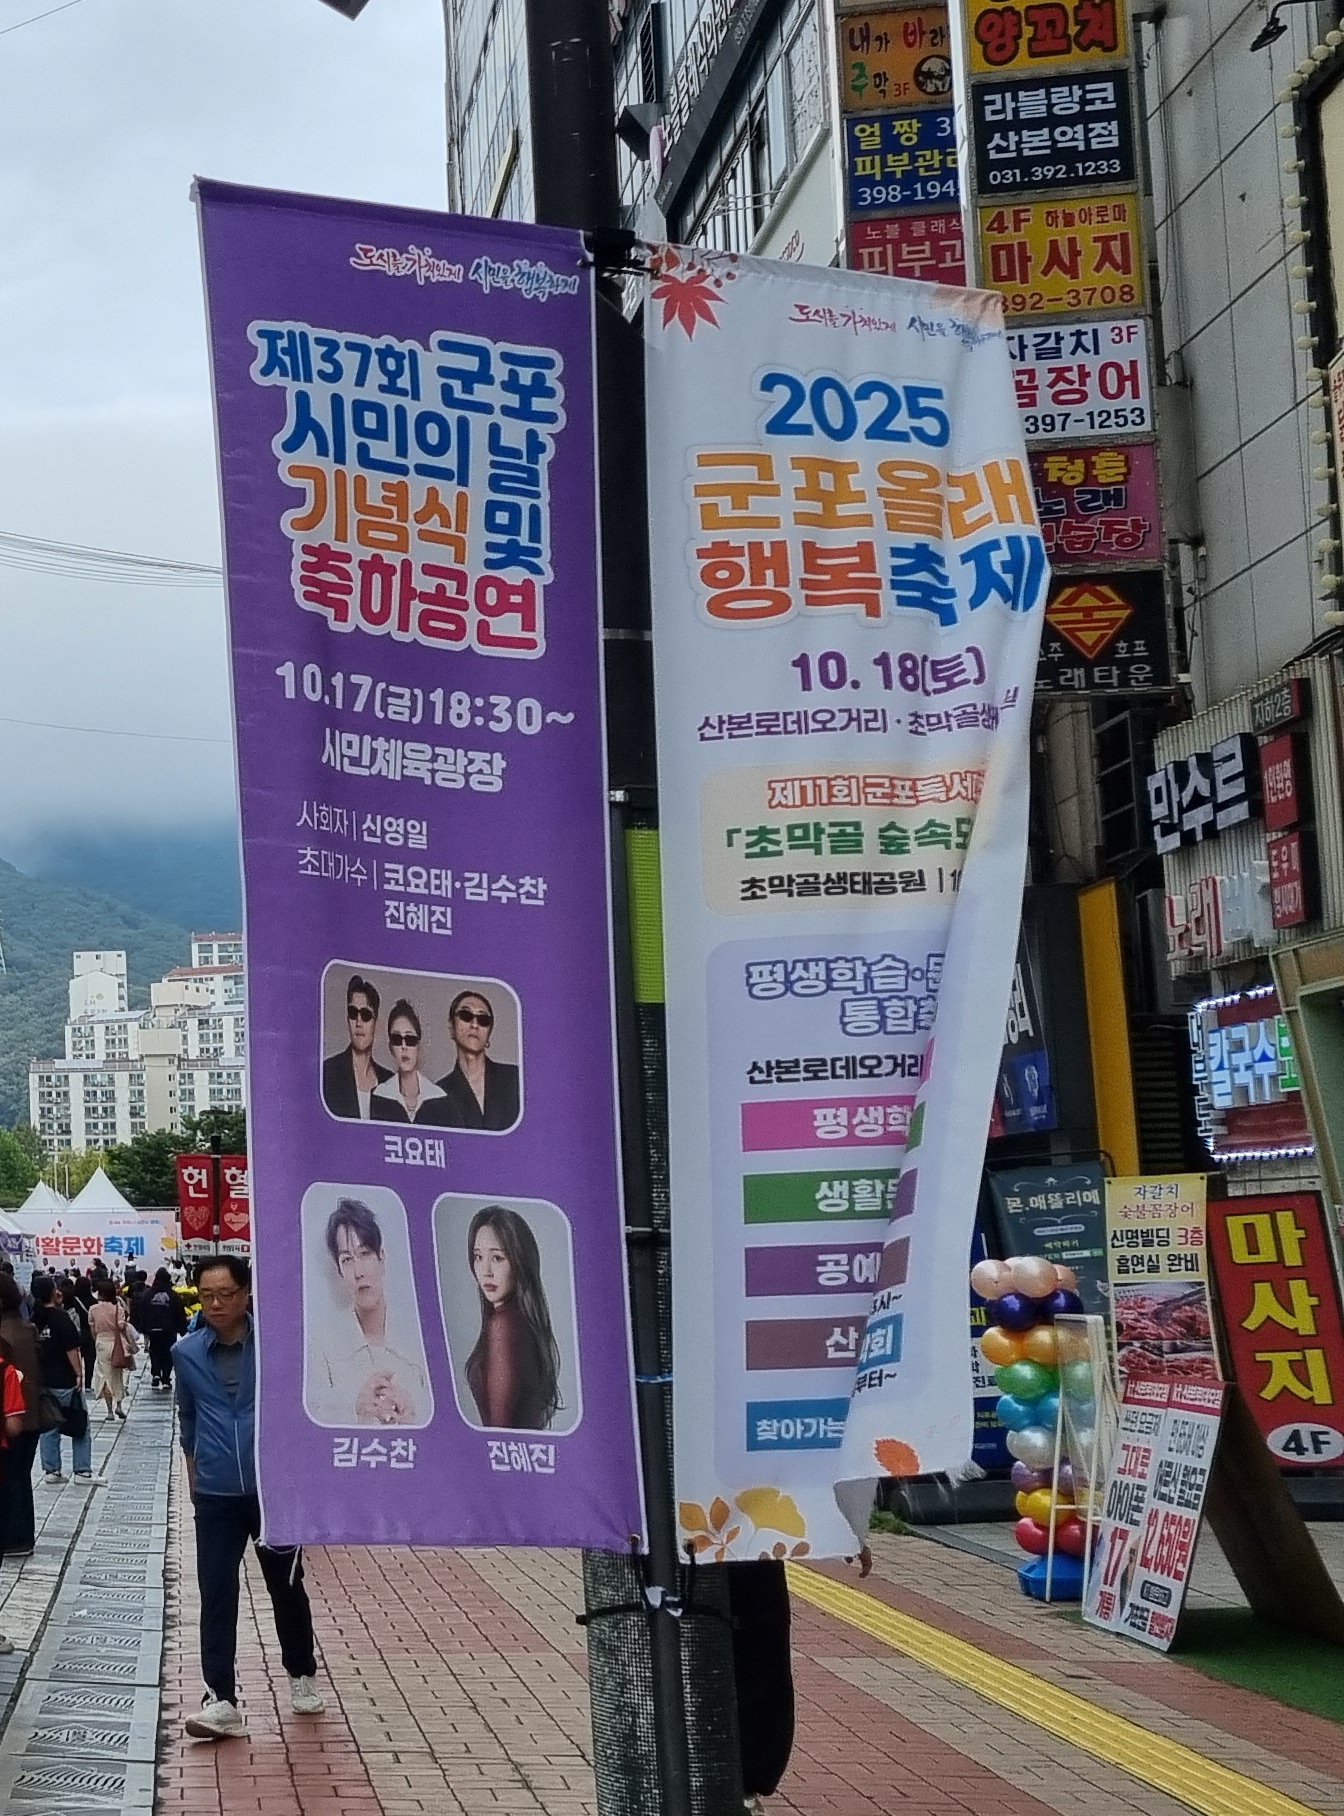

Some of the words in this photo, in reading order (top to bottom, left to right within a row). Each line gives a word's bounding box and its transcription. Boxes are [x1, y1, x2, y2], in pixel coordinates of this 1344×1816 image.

[848, 21, 891, 55] 내가
[851, 61, 889, 98] 주막
[893, 82, 910, 97] 3F
[983, 82, 1117, 121] 라블랑코
[986, 120, 1120, 160] 산본역점
[989, 159, 1122, 185] 031.392.1233
[866, 221, 903, 240] 노블
[986, 208, 1031, 235] 4F
[1045, 203, 1128, 229] 하늘아로마
[989, 232, 1133, 285] 마사지
[1110, 325, 1138, 344] 3F
[256, 327, 421, 402] 제37회
[436, 338, 560, 425] 군포
[758, 371, 951, 447] 2025
[1025, 407, 1145, 433] 397-1253
[281, 391, 470, 487] 시민의
[488, 421, 547, 500] 날
[1043, 450, 1130, 485] 청춘
[693, 452, 1040, 542] 군포올래
[288, 464, 470, 566] 기념식
[484, 496, 544, 575] 및
[299, 541, 541, 652] 축하공연
[696, 534, 1045, 626] 행복축제
[1115, 640, 1149, 659] 호프
[791, 650, 861, 692] 10.
[872, 645, 987, 698] 18(토)
[1034, 662, 1154, 691] 노래타운
[1253, 686, 1293, 726] 지하2층
[697, 707, 888, 743] 산본로데오거리
[322, 727, 506, 792] 시민체육광장
[768, 776, 861, 809] 제11회
[1147, 733, 1250, 856] 만수르
[296, 800, 348, 837] 사회자
[362, 813, 428, 849] 신영일
[298, 847, 367, 887] 초대가수
[740, 868, 927, 901] 초막골생태공원
[384, 899, 453, 936] 진혜진
[747, 1052, 924, 1084] 산본로데오거리
[1208, 1023, 1277, 1110] 칼국수
[384, 1134, 446, 1169] 코요태
[181, 1165, 209, 1199] 헌
[1133, 1182, 1180, 1200] 자갈치
[35, 1235, 146, 1257] 활문화축제
[1110, 1227, 1171, 1249] 신명빌딩
[1176, 1225, 1205, 1247] 3층
[815, 1250, 880, 1287] 공예
[1115, 1253, 1161, 1275] 흡연실
[1166, 1251, 1201, 1273] 완비
[1226, 1209, 1334, 1405] 마사지
[332, 1437, 417, 1470] 김수찬
[486, 1440, 557, 1475] 진혜진
[1116, 1443, 1152, 1479] 그대로
[1281, 1428, 1332, 1457] 4F
[1106, 1479, 1148, 1528] 아이폰
[1103, 1526, 1131, 1588] 17
